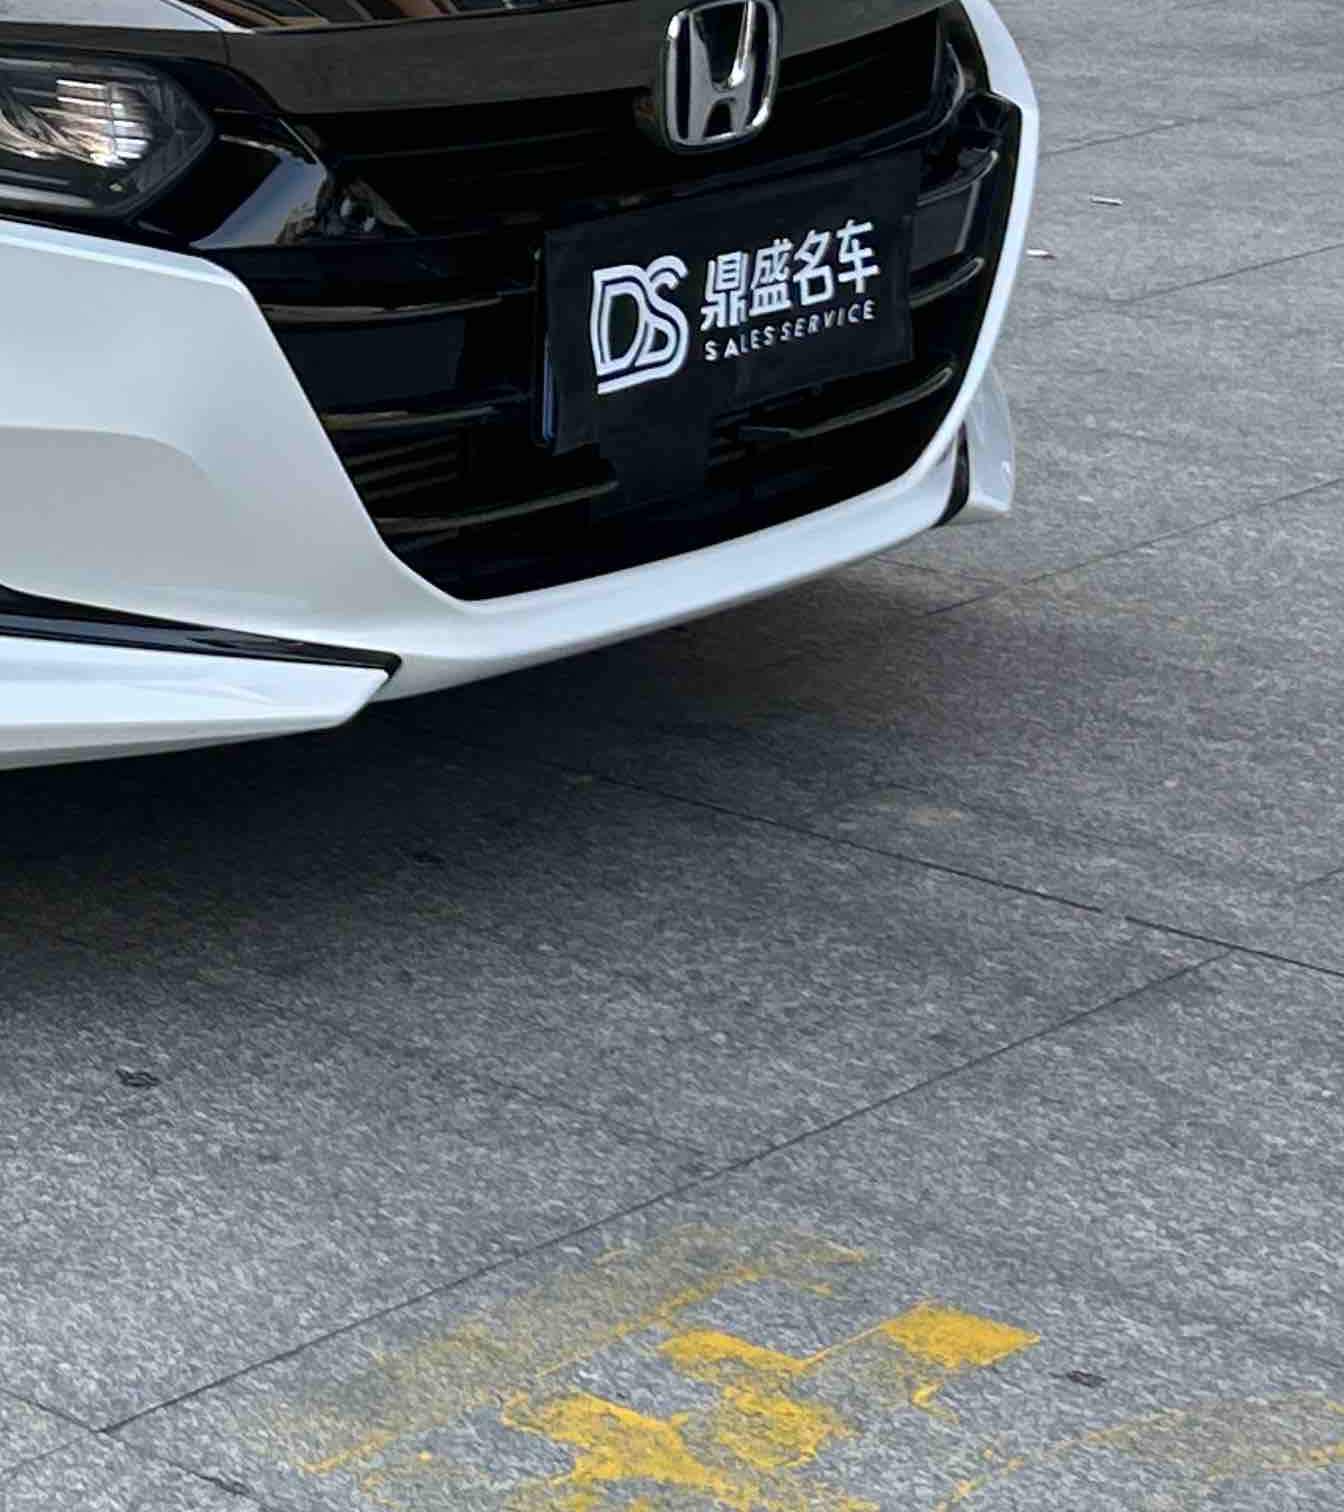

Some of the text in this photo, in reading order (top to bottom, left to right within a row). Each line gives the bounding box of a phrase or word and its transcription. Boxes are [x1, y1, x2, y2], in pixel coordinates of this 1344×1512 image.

[589, 255, 690, 395] DS
[700, 219, 880, 332] 鼎盛名车
